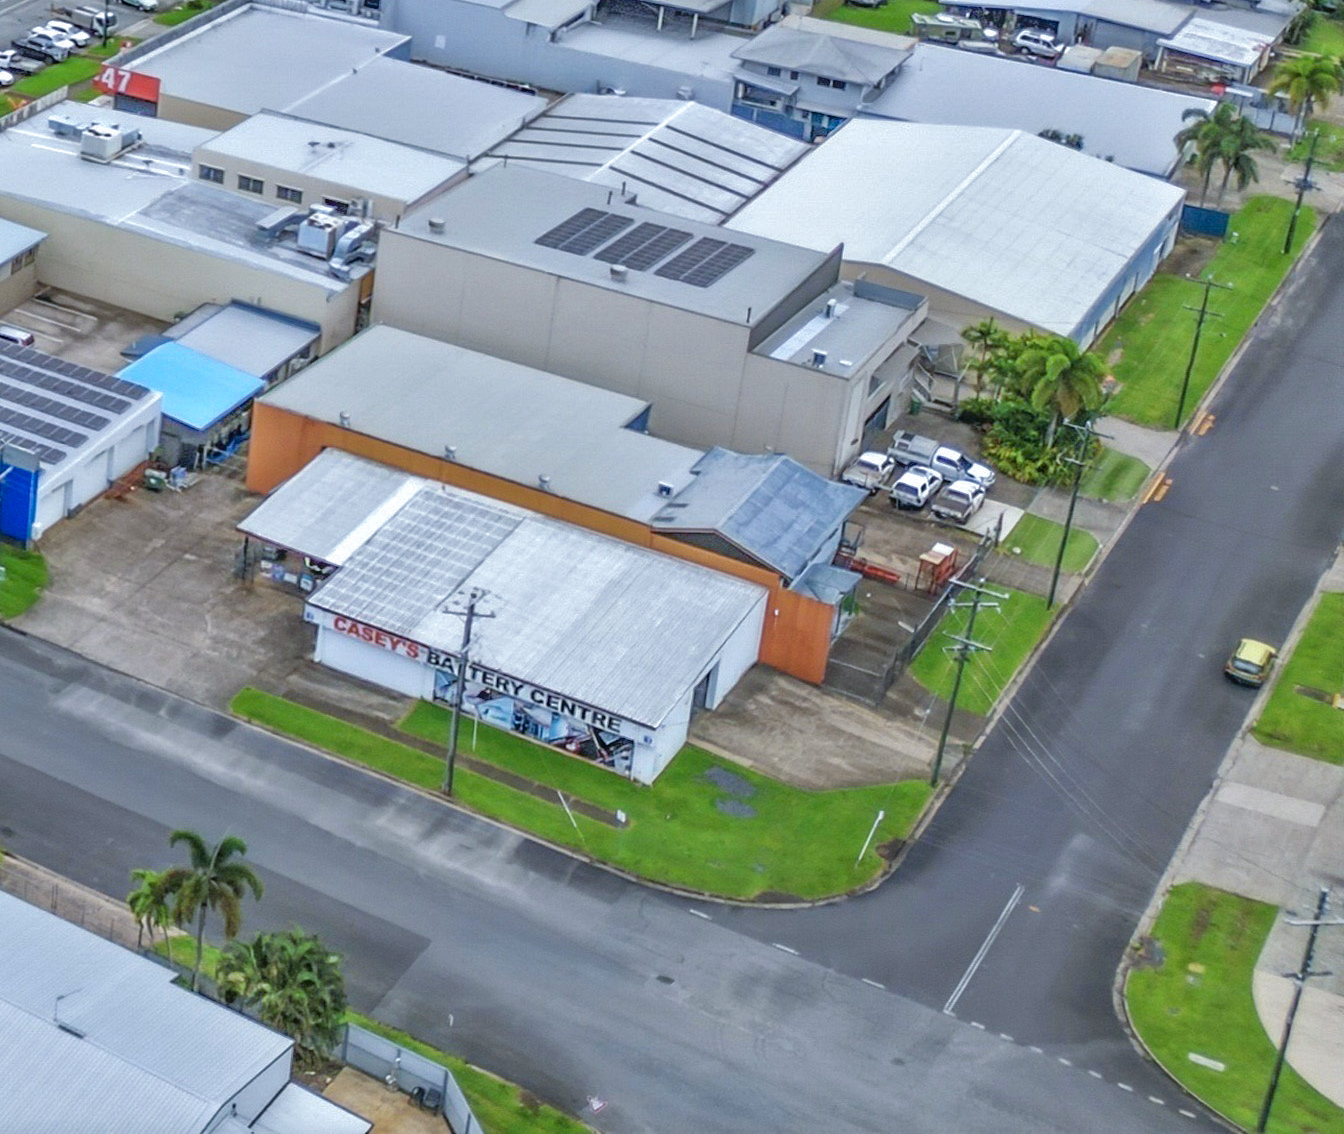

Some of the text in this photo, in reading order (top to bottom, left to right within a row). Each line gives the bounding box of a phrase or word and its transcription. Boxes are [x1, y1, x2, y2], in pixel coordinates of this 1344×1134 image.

[333, 616, 623, 732] CASEY'S BATERY CENTRE
